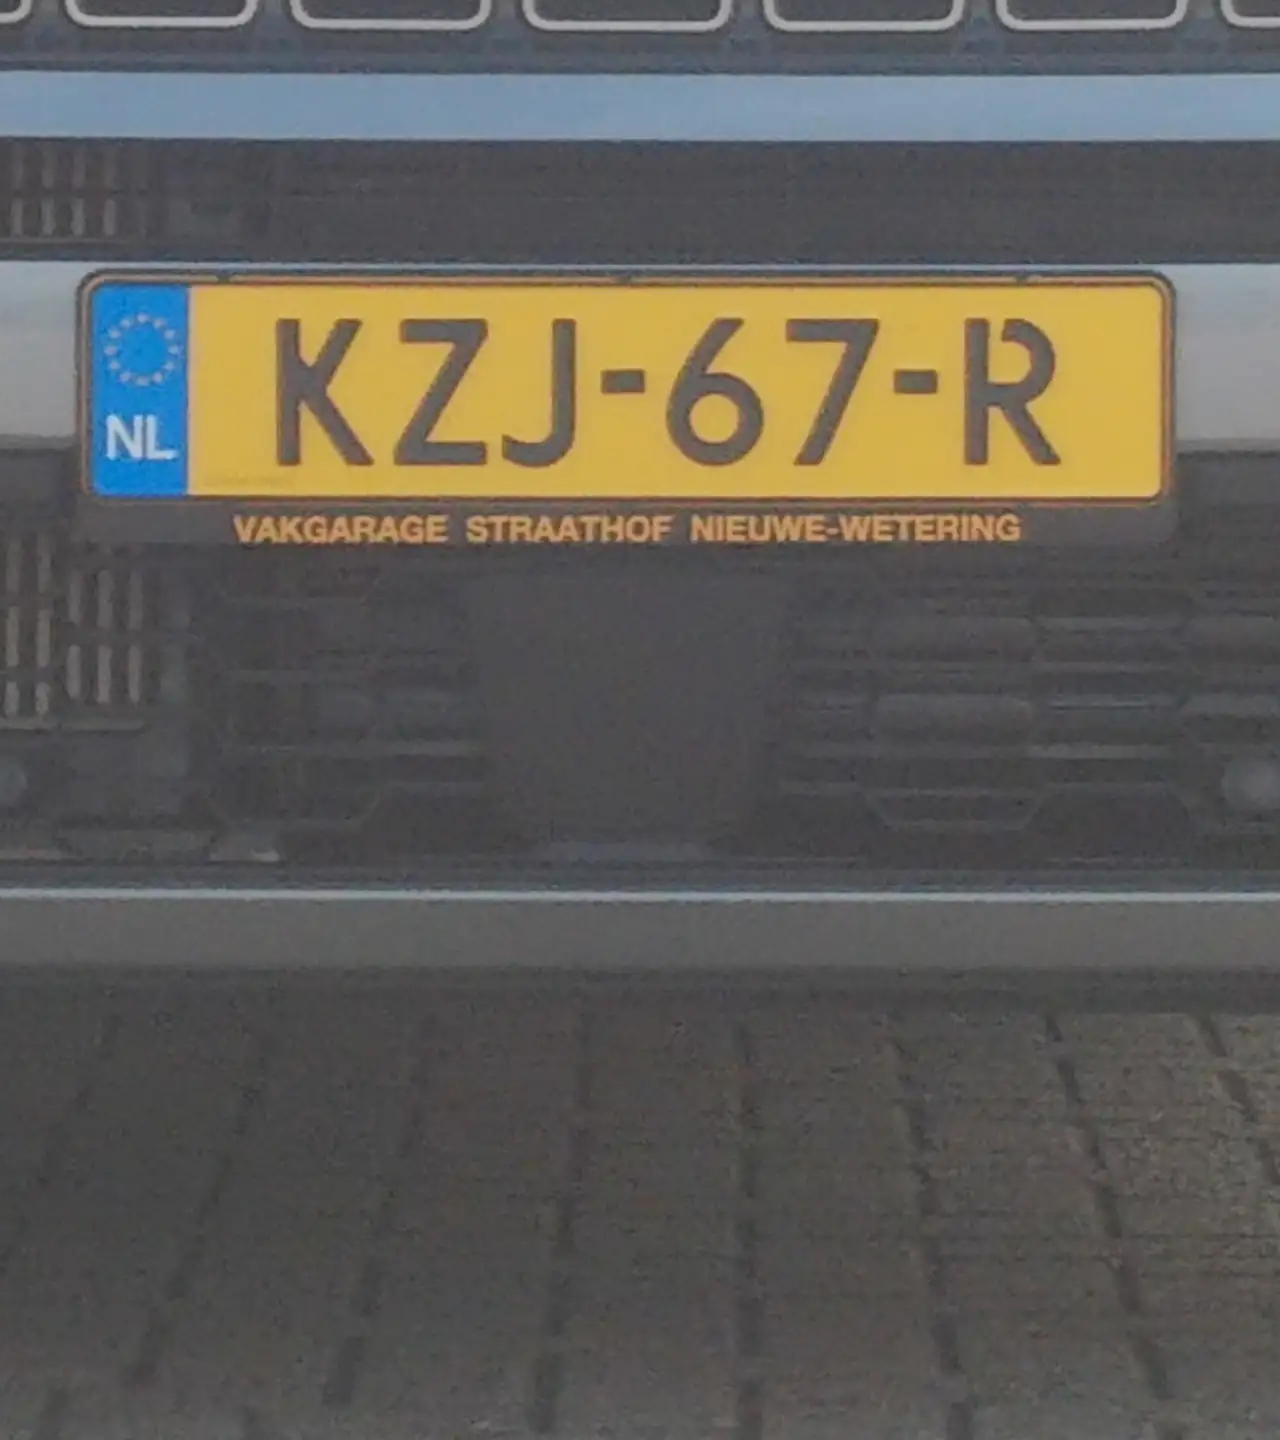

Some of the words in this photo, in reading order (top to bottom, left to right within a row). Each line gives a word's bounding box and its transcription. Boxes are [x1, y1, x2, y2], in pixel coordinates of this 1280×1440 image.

[275, 317, 1060, 468] KZJ-67-R
[106, 415, 177, 461] NL
[233, 515, 448, 545] VAKGARAGE
[466, 515, 672, 545] STRAATHOF
[690, 513, 1021, 545] NIEUWE-WETERING
